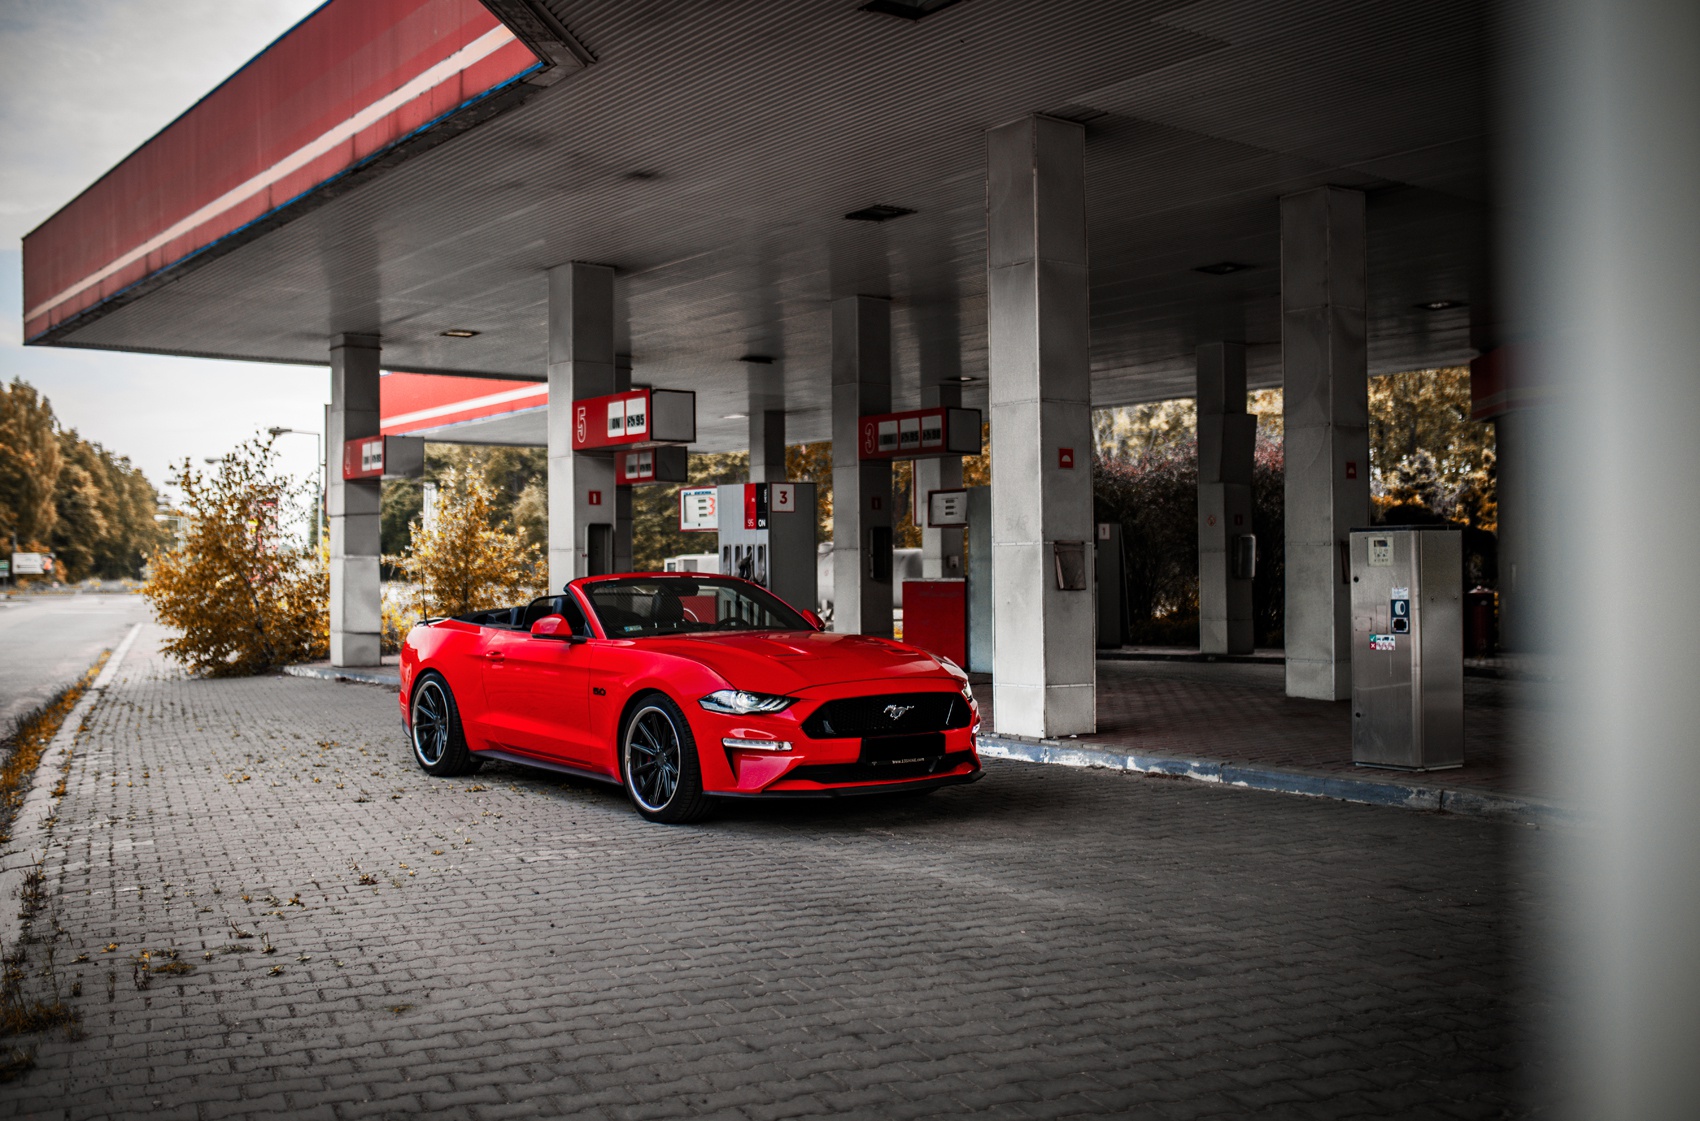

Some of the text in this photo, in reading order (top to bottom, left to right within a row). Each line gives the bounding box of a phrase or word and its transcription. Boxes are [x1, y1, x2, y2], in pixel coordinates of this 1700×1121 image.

[577, 406, 586, 443] 5
[612, 418, 620, 429] ON
[865, 423, 875, 454] 3
[779, 490, 788, 504] 3
[708, 497, 715, 516] 3
[747, 519, 754, 527] 95
[758, 519, 766, 527] ON
